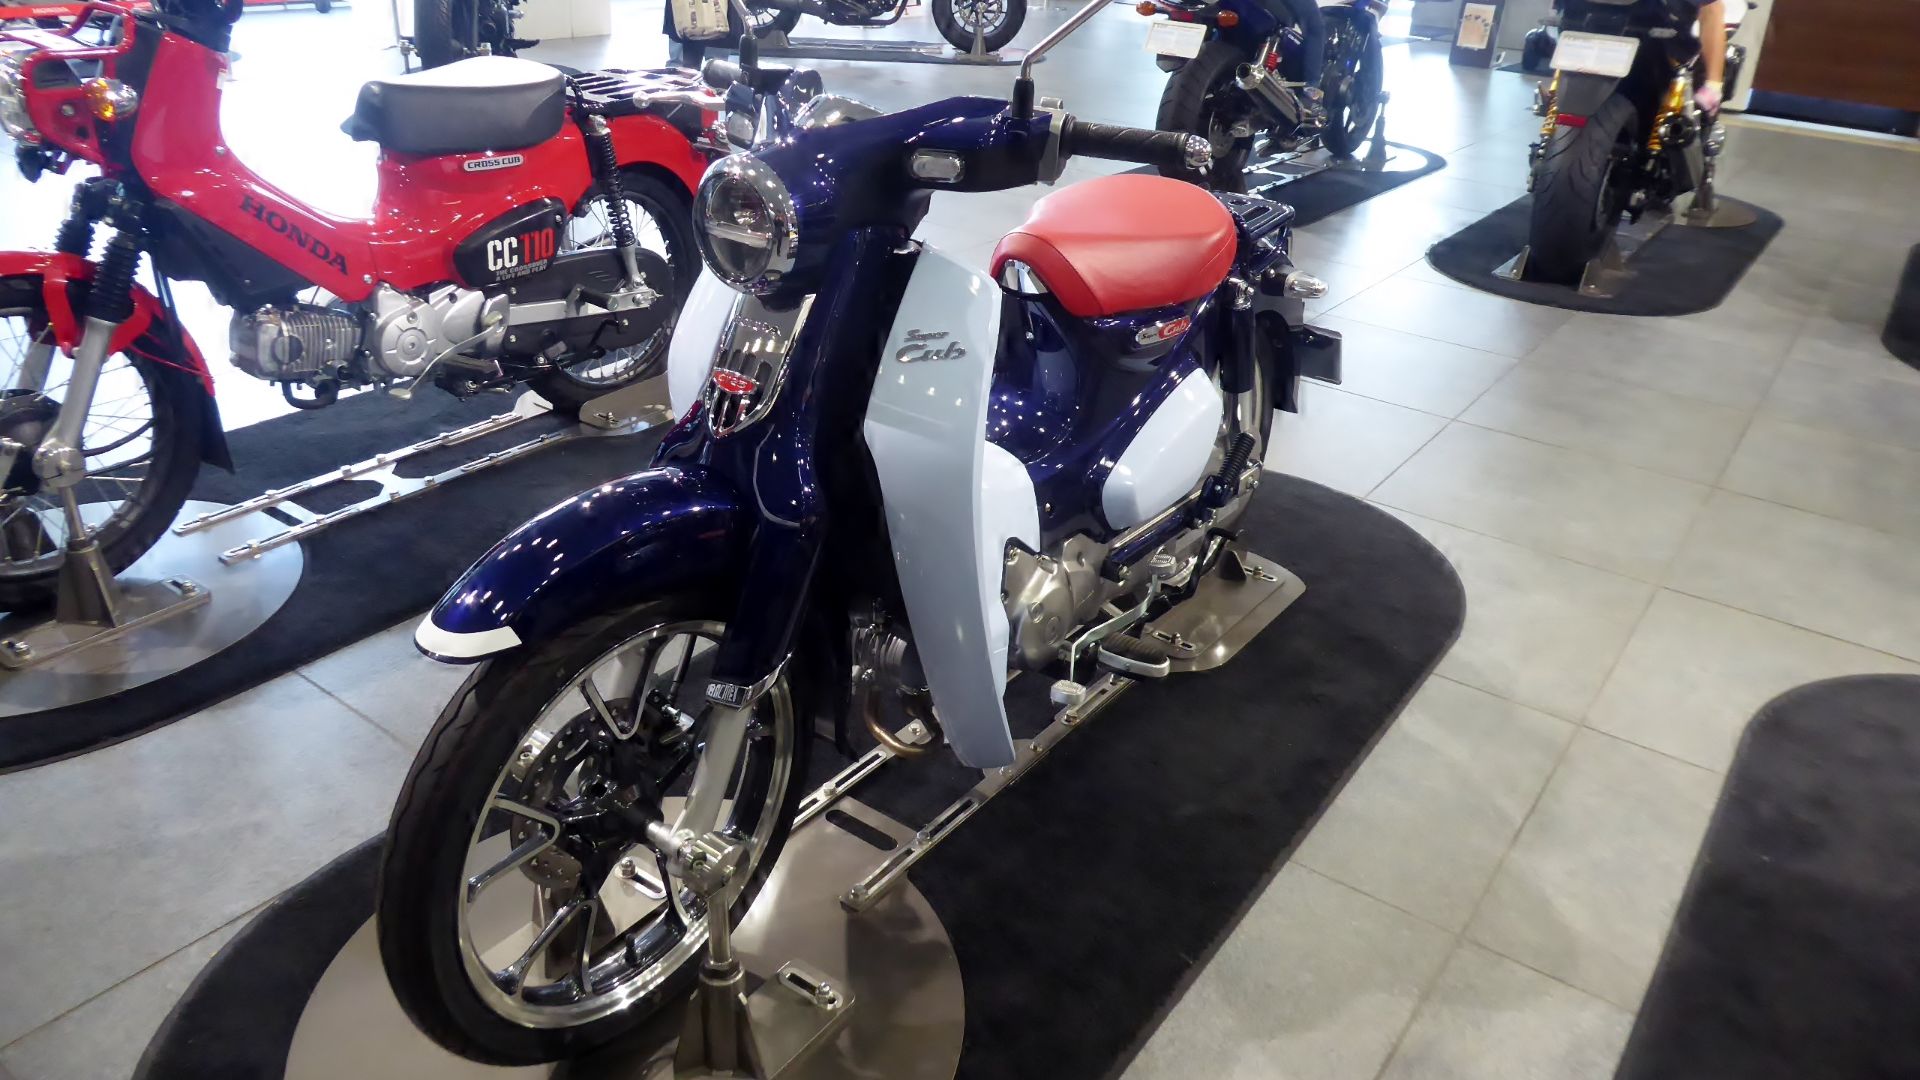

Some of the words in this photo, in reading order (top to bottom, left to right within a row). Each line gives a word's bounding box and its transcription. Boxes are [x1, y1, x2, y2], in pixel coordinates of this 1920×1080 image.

[467, 160, 500, 169] CROSS
[502, 156, 520, 165] CUB
[239, 195, 348, 276] HONDA
[1163, 319, 1187, 336] Cub
[896, 341, 966, 363] Cub
